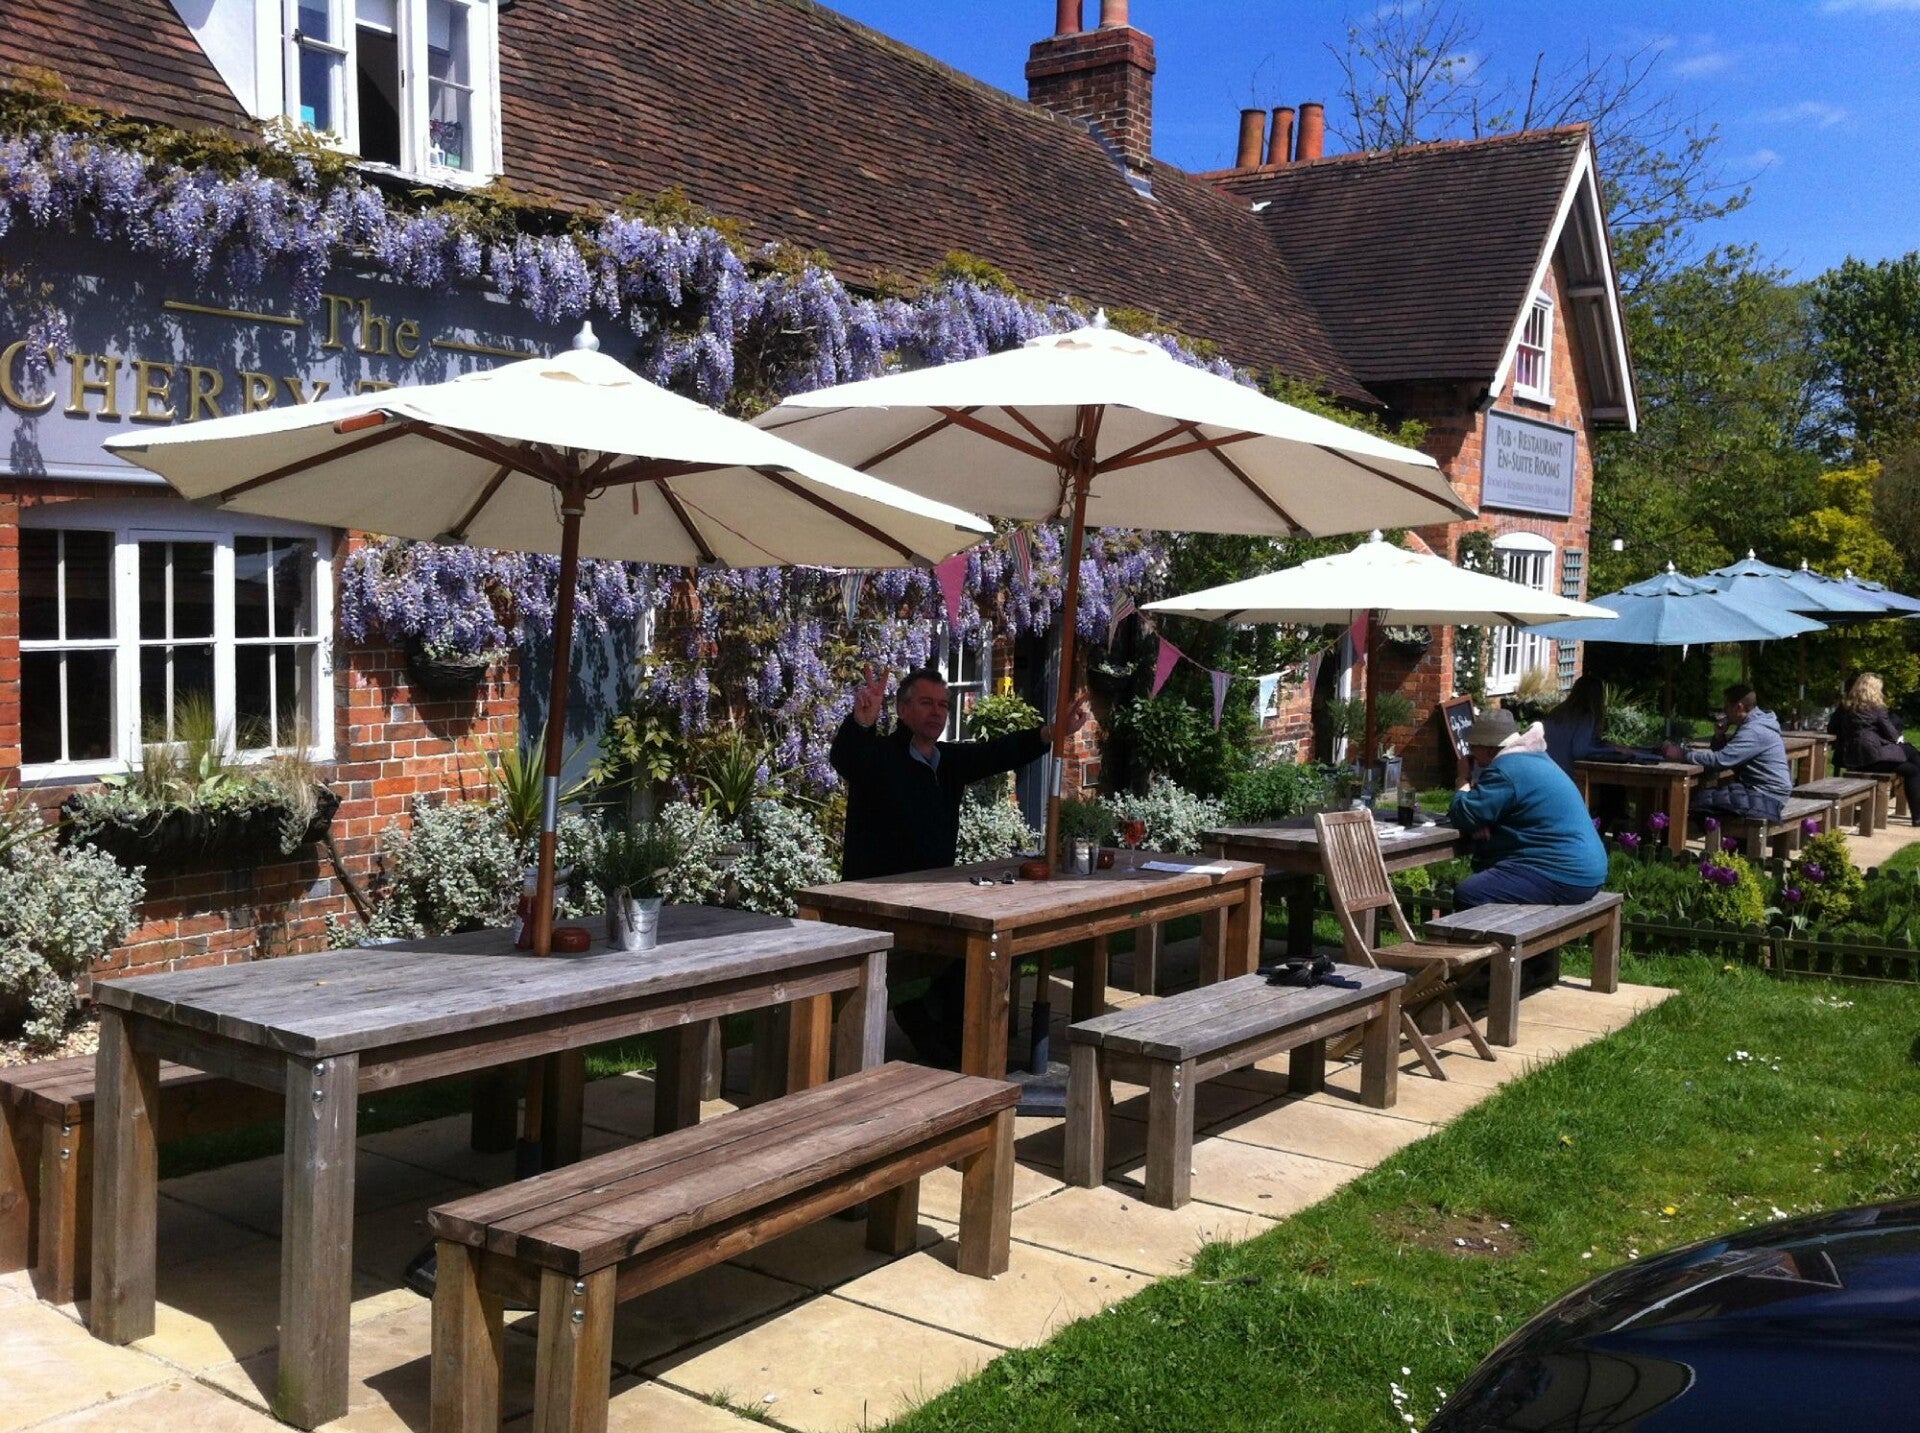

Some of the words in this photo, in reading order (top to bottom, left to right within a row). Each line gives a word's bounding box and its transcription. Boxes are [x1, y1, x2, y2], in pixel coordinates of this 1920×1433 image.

[322, 293, 421, 359] The
[1496, 425, 1512, 448] PUB
[1518, 430, 1563, 458] RESTAURANT
[1534, 456, 1560, 479] ROOMS
